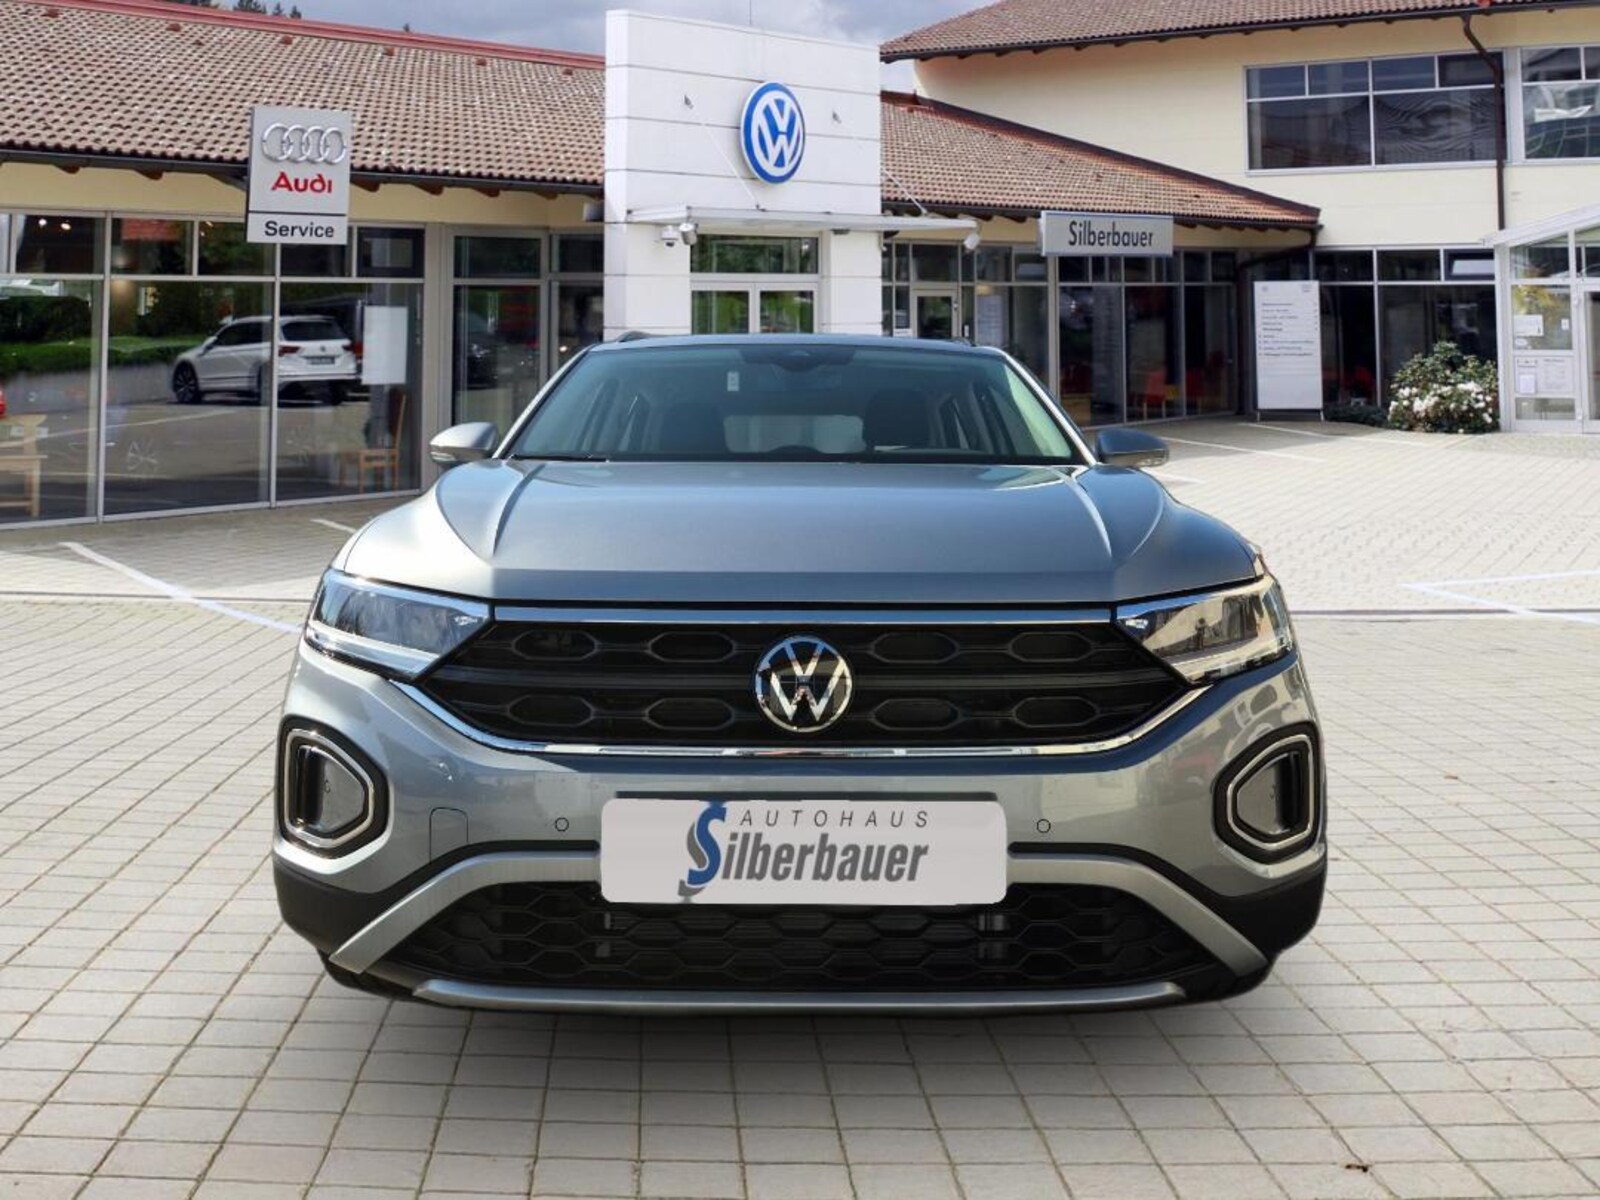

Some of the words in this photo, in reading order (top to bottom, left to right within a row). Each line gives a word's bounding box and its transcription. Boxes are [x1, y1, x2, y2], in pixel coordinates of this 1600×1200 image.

[271, 171, 333, 193] Audi
[264, 220, 334, 238] Service
[1068, 220, 1154, 247] Silberbauer
[740, 809, 928, 828] AUTOHAUS
[683, 801, 929, 888] Silberbauer
